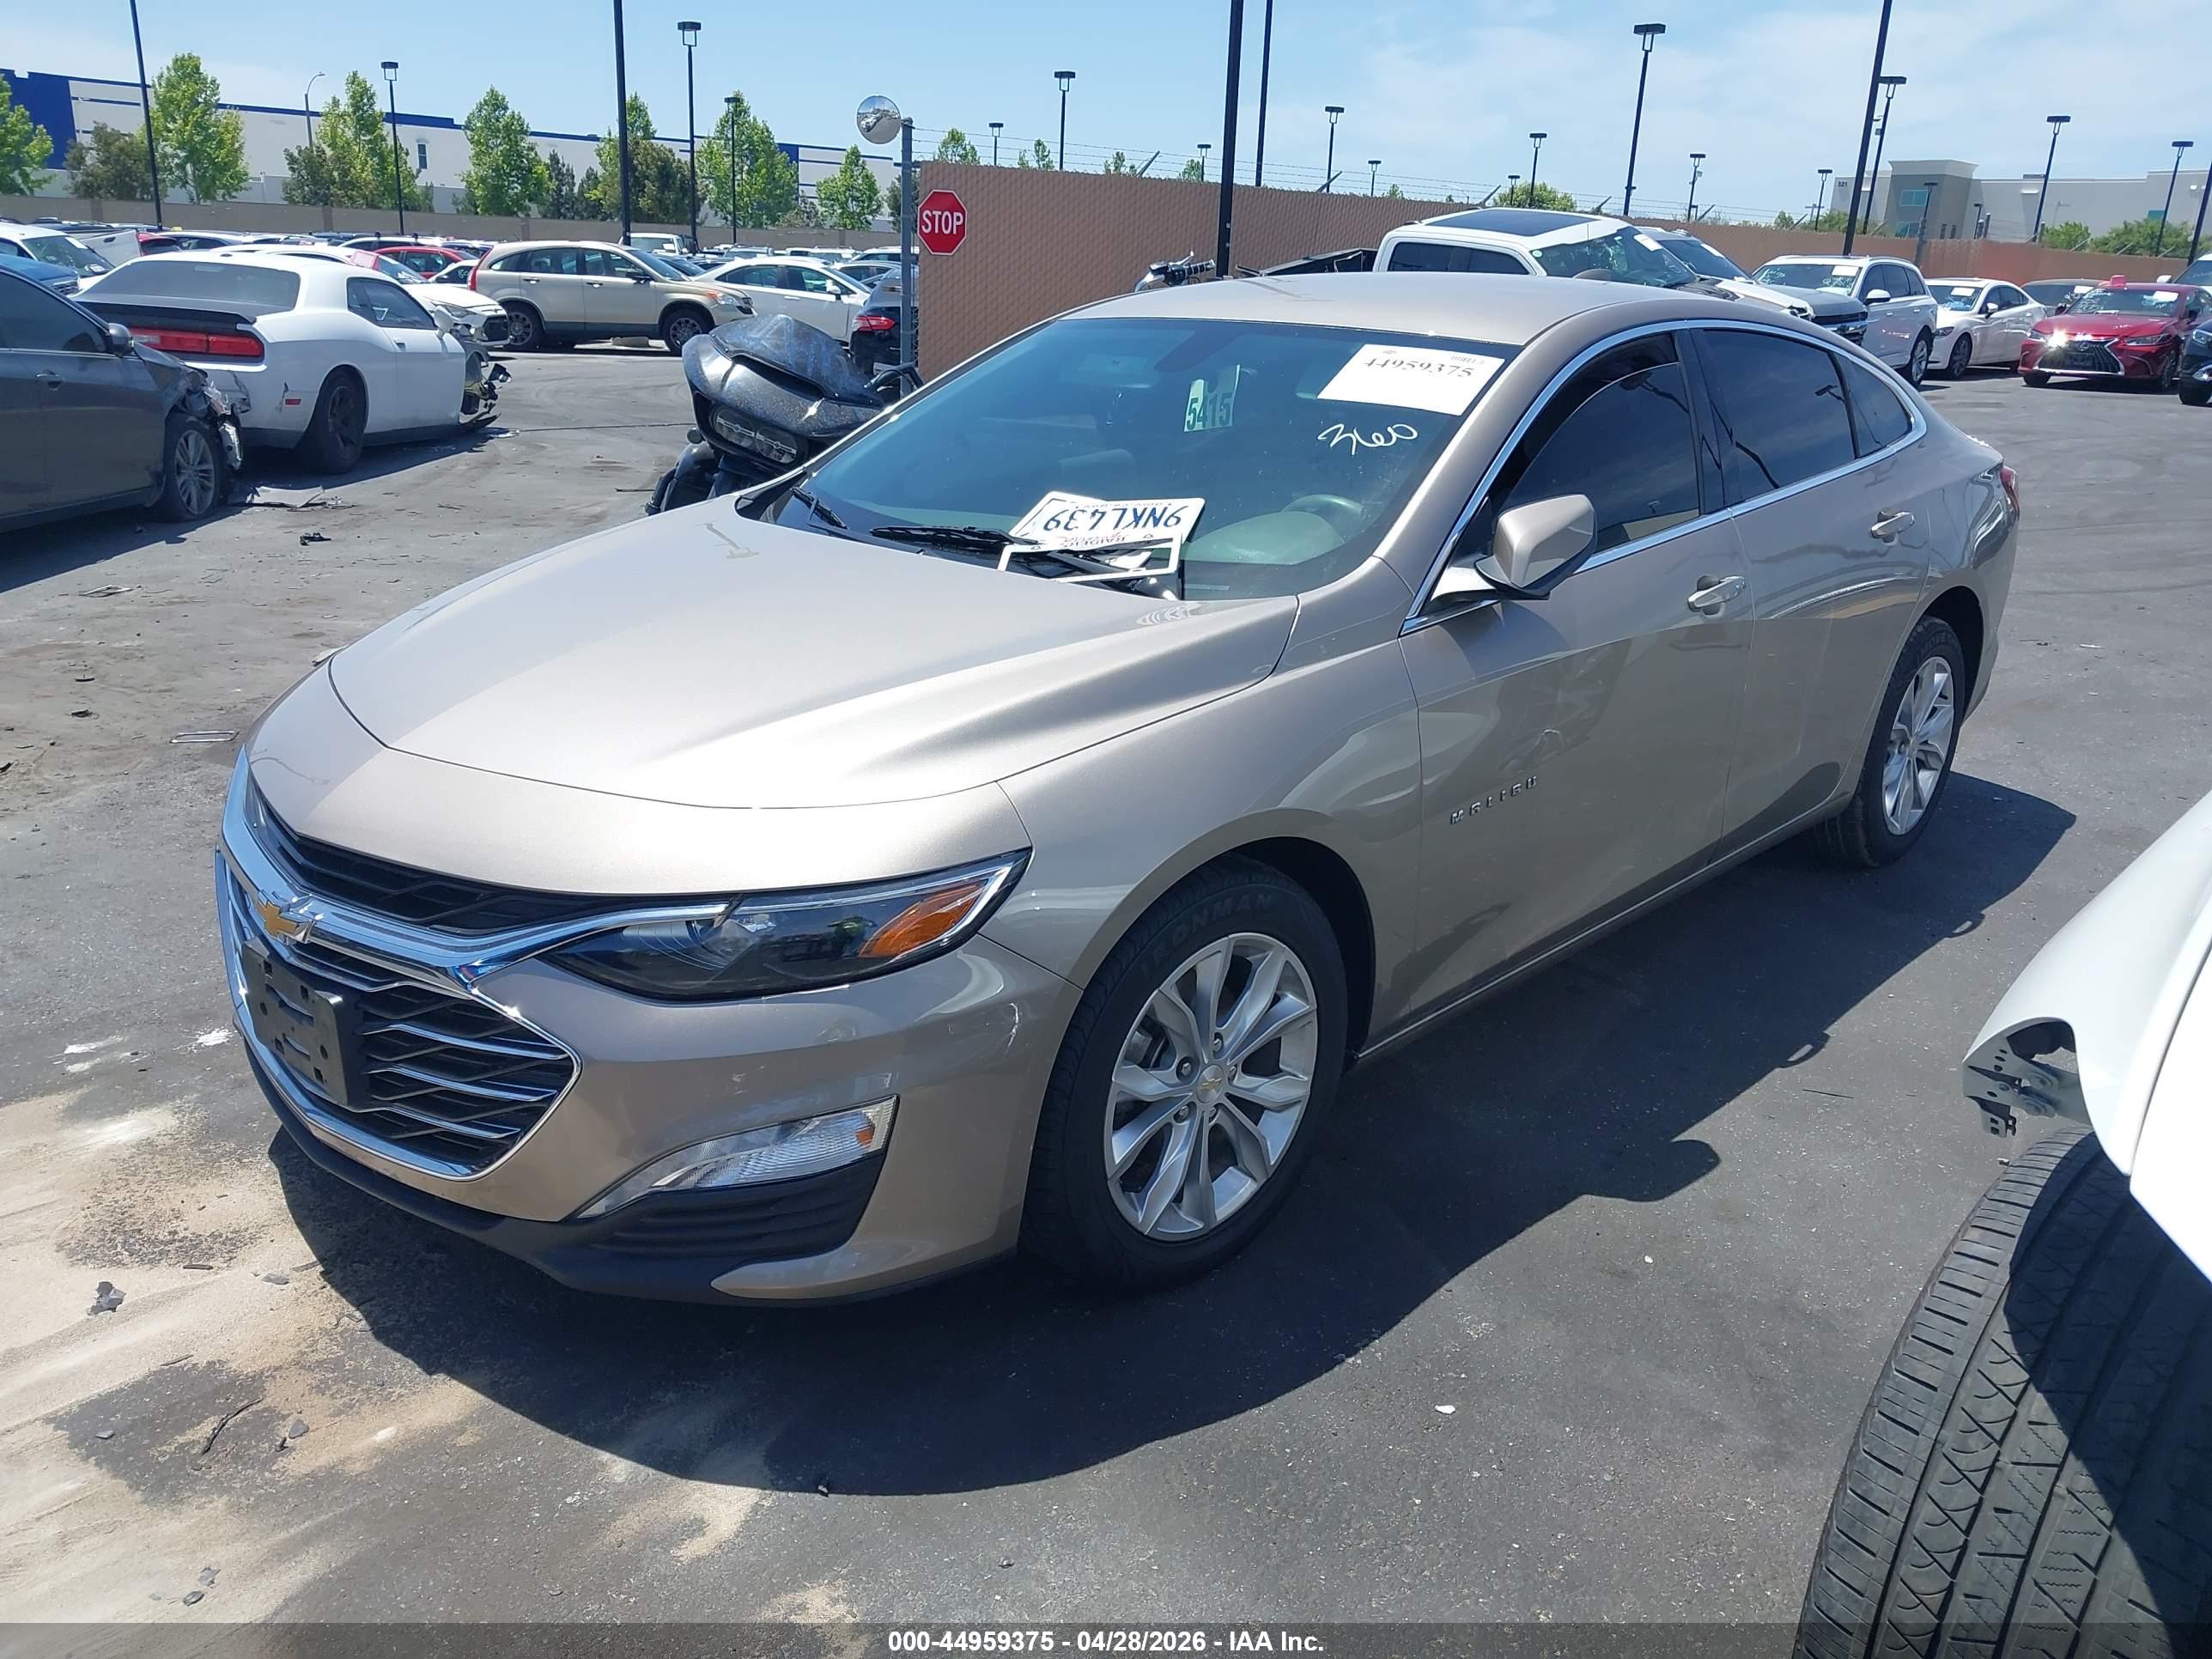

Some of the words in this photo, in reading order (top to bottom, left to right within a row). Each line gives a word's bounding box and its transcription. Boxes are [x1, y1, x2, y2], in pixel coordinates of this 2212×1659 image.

[921, 210, 963, 234] STOP
[1364, 357, 1474, 378] 44959375
[1186, 393, 1232, 430] 5415
[1317, 423, 1419, 456] 360
[1042, 505, 1189, 532] 9NKL439
[1449, 775, 1537, 824] MALIBU
